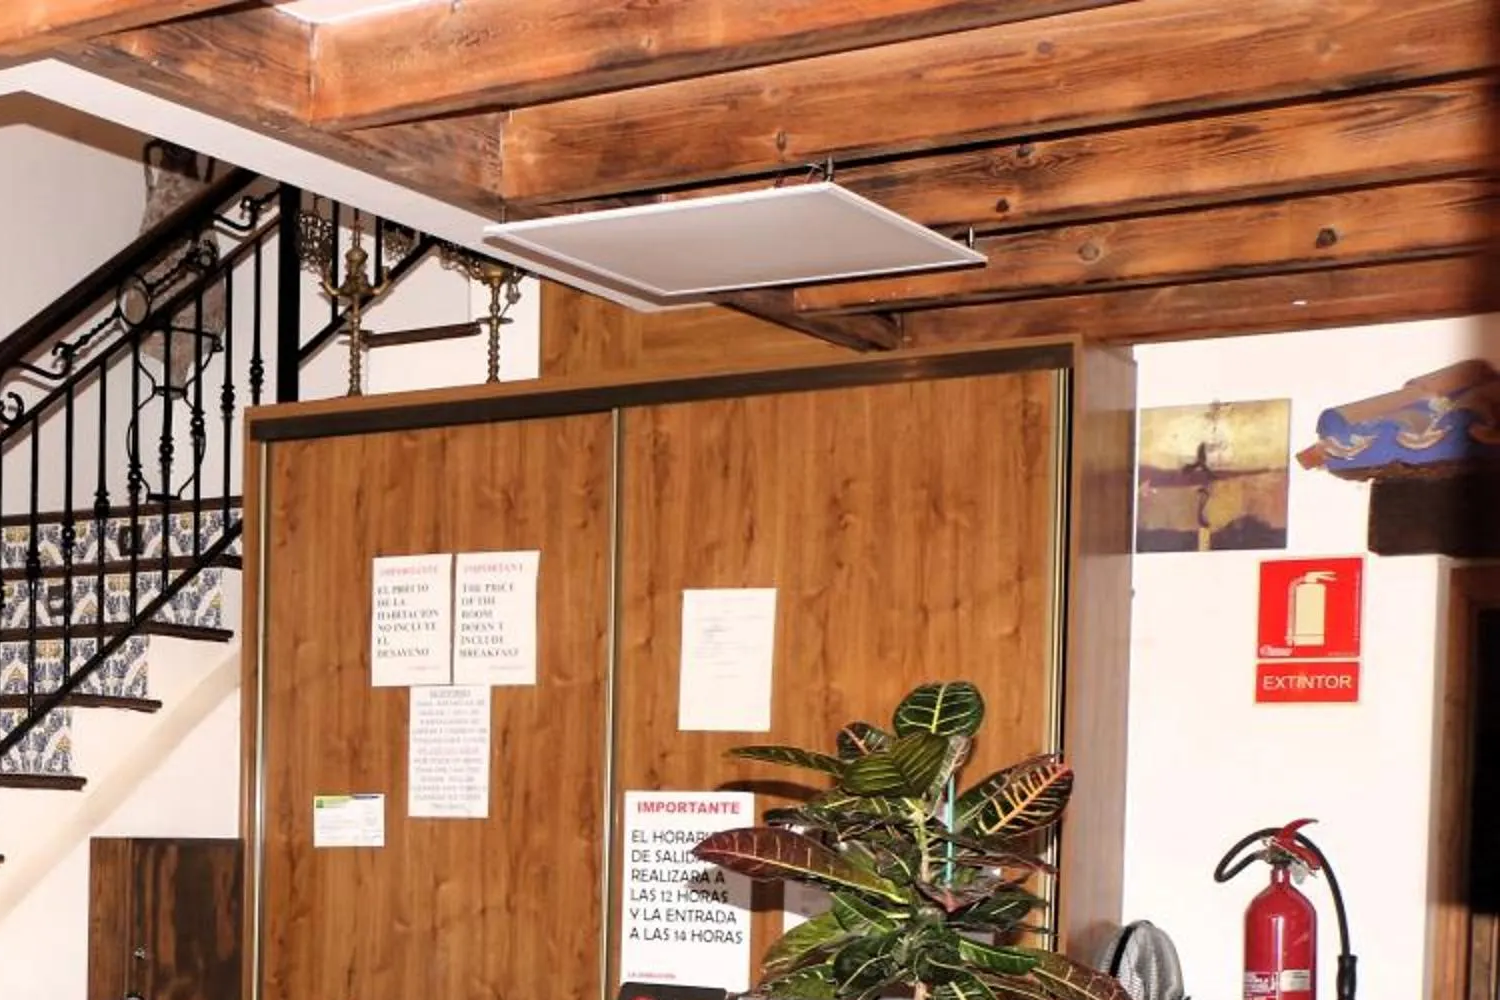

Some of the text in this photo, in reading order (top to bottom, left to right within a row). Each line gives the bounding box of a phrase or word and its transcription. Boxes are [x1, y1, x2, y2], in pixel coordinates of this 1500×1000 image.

[1263, 674, 1352, 691] EXTINTOR
[637, 801, 741, 814] IMPORTANTE
[631, 829, 648, 843] EL
[631, 849, 699, 864] DE SALID
[631, 868, 726, 883] REALIZARA A
[630, 888, 729, 904] LAS 12 HORAS
[643, 908, 662, 921] LA
[665, 908, 737, 925] ENTRADA
[629, 926, 640, 941] A
[643, 927, 670, 941] LAS
[690, 929, 743, 945] HORAS
